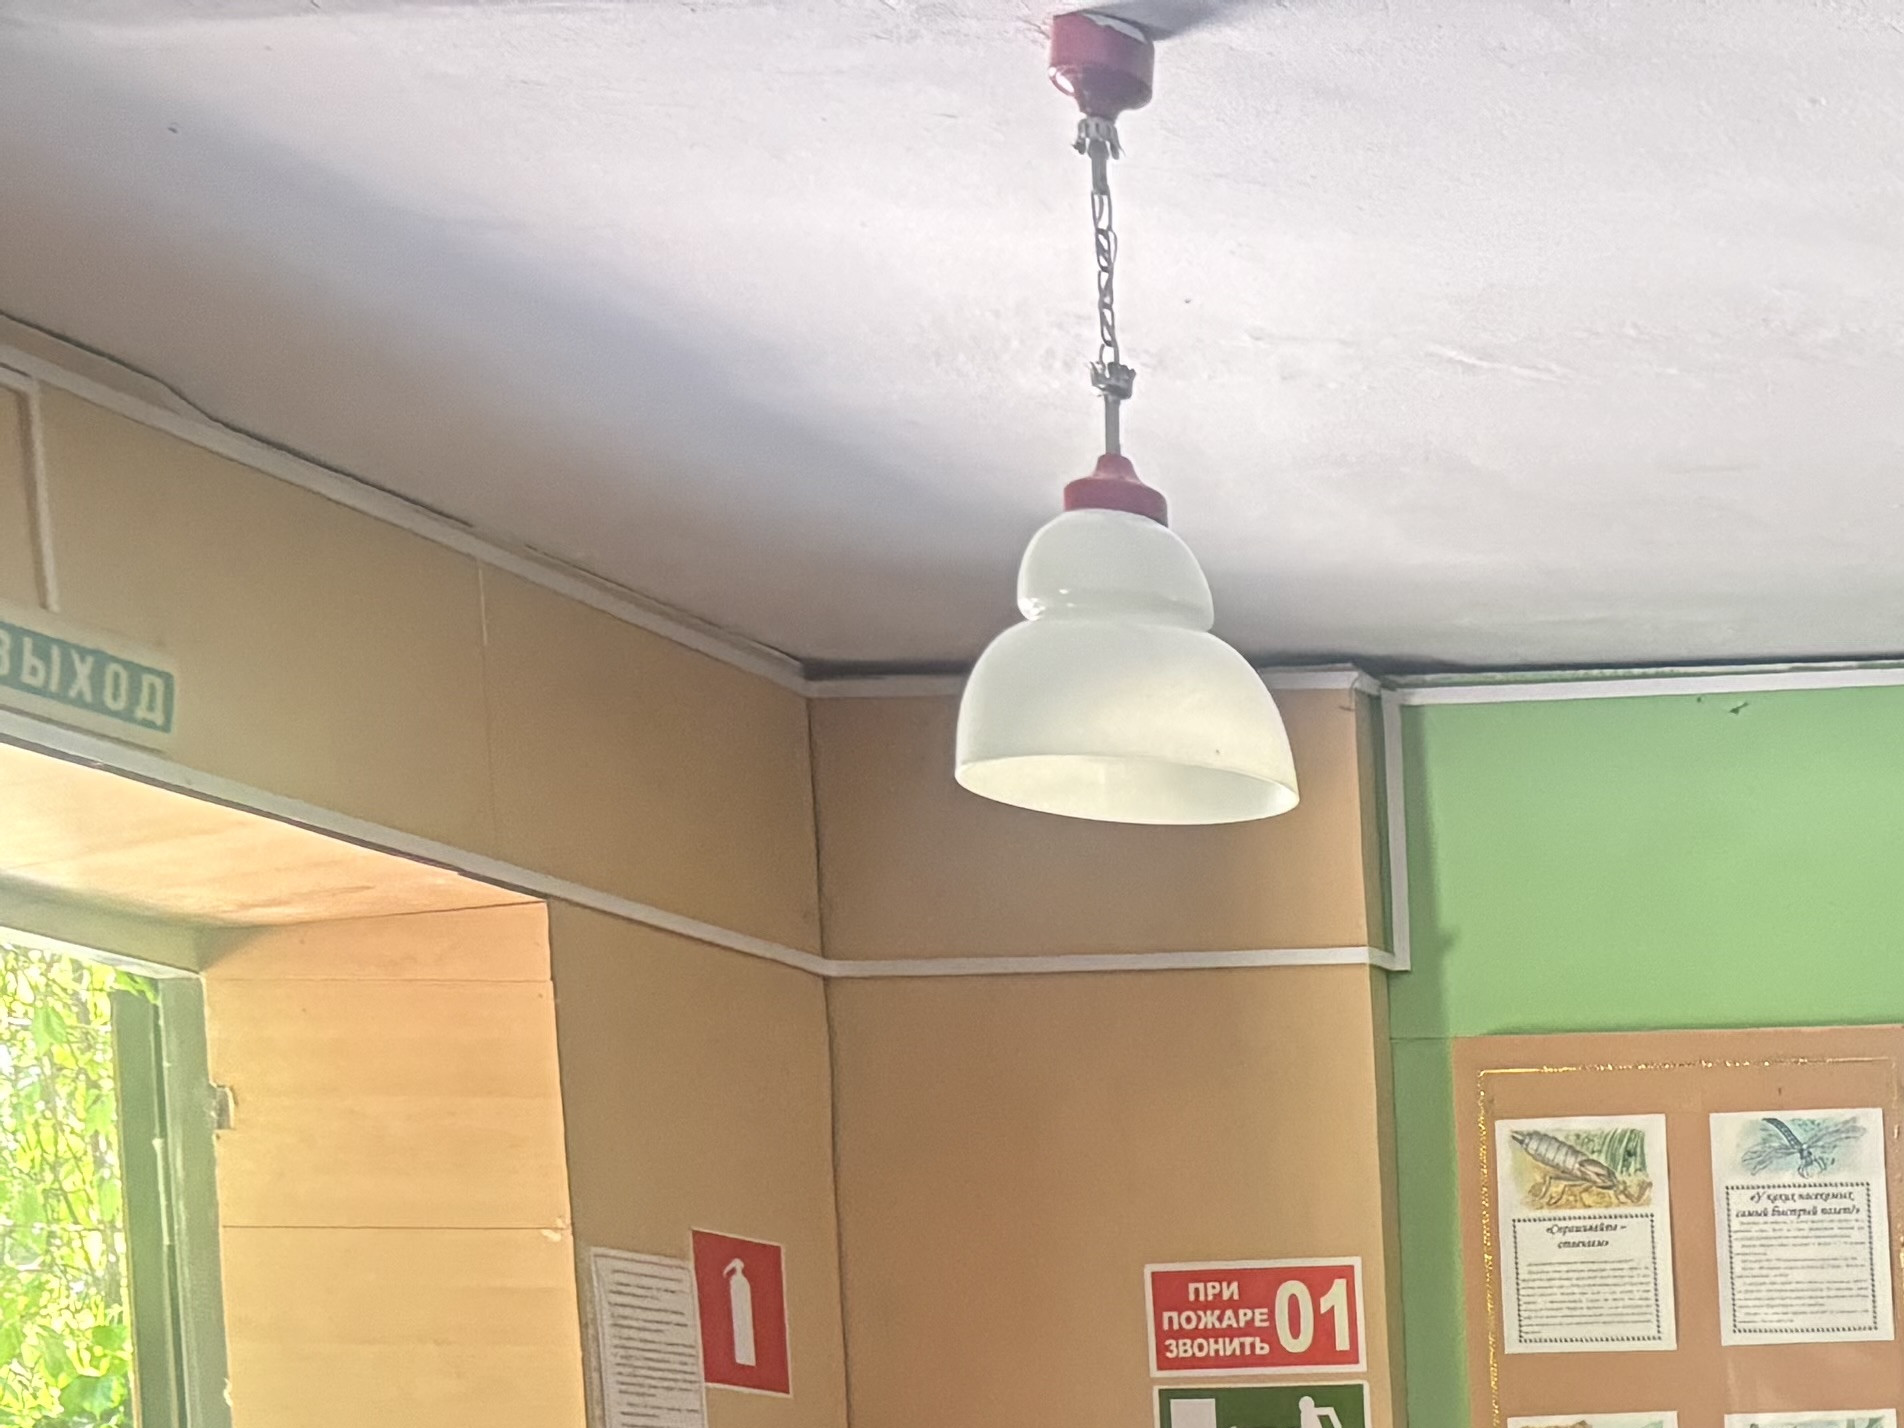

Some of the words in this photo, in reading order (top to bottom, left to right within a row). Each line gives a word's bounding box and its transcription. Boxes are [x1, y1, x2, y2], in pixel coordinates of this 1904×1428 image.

[1188, 1281, 1239, 1302] ПРИ
[1162, 1308, 1270, 1331] ПОЖАРЕ
[1275, 1278, 1350, 1353] 01
[1164, 1336, 1270, 1358] ЗВОНИТЬ
